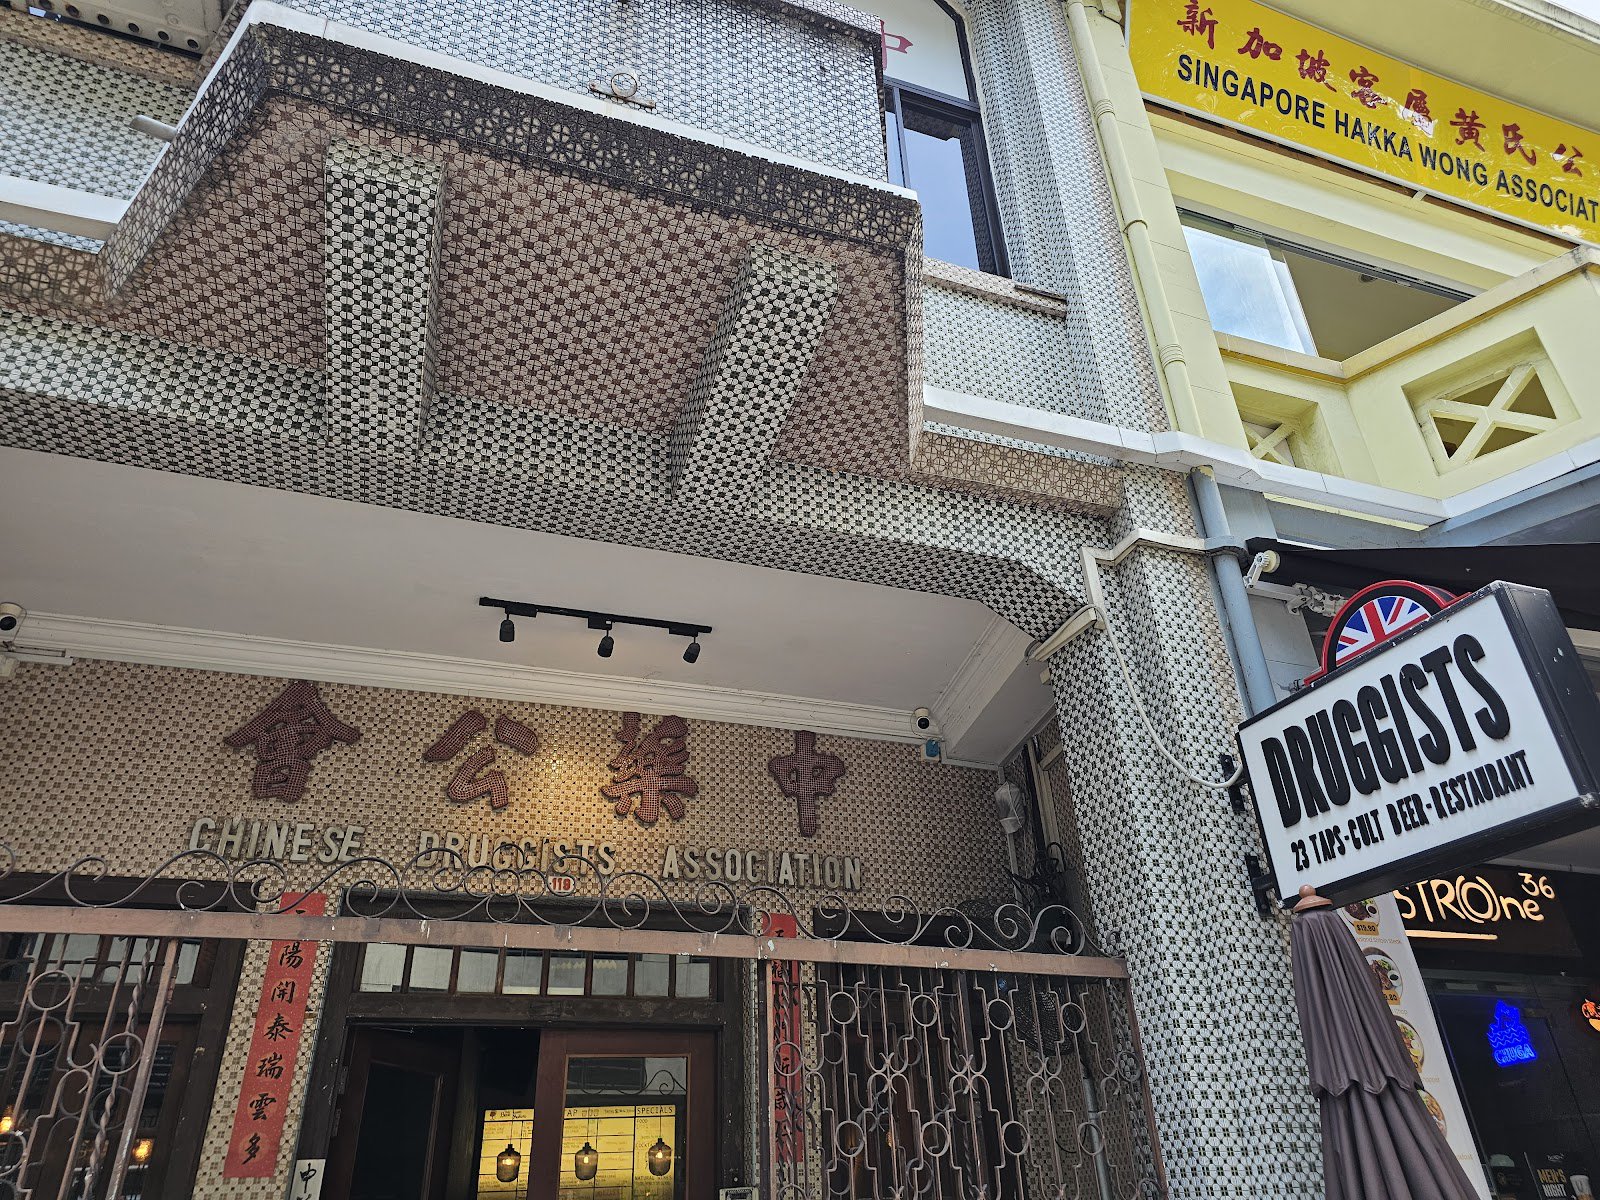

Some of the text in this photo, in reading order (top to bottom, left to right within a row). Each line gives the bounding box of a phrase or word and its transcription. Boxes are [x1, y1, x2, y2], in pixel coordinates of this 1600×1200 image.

[1178, 54, 1599, 223] SINGAPORE HAKKA WONG ASSOCIAT
[1260, 633, 1511, 829] DRUGGISTS
[188, 817, 862, 891] CHINESE DRUGGISTS ASSOCIATION
[1290, 839, 1310, 872] 23
[1518, 872, 1556, 899] 36
[240, 909, 311, 1165] 陽開泰瑞雲多
[636, 1106, 673, 1115] SPECIALS
[1542, 1184, 1567, 1198] NIGHT
